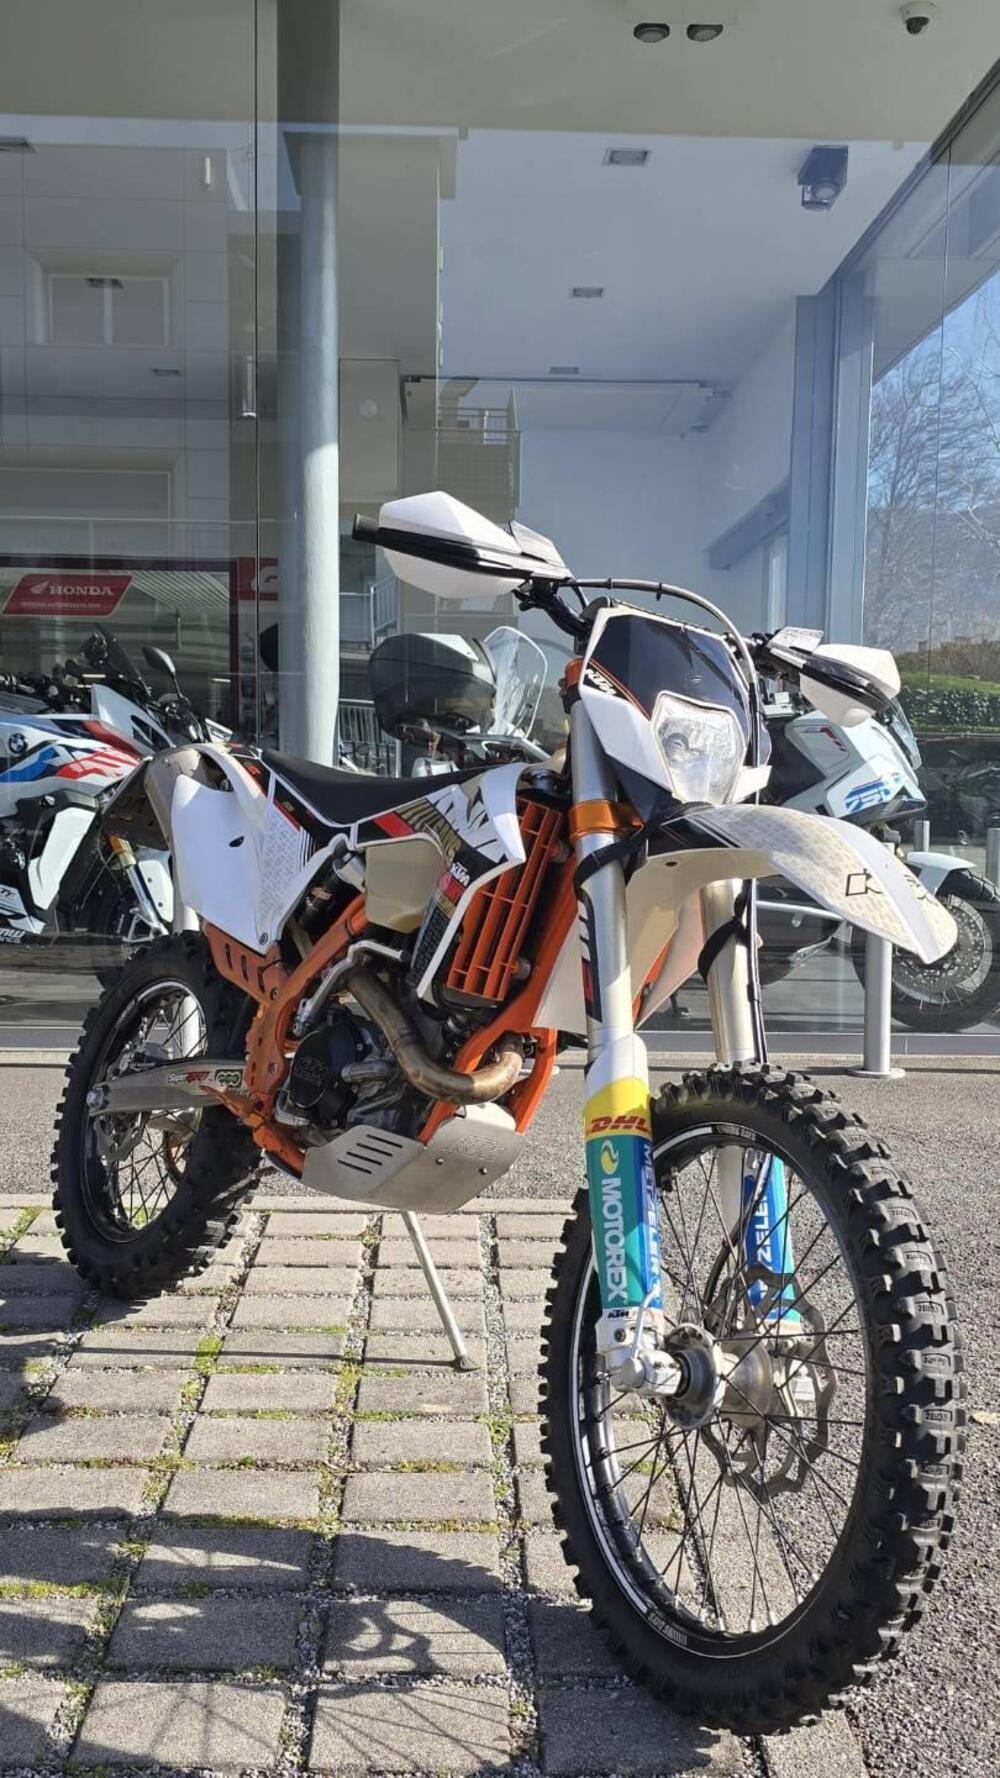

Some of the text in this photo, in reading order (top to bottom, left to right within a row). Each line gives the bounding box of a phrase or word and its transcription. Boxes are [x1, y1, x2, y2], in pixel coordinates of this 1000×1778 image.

[49, 585, 114, 596] HONDA
[450, 861, 471, 888] KTM
[591, 1115, 649, 1133] DHL
[602, 1177, 628, 1302] MOTOREX
